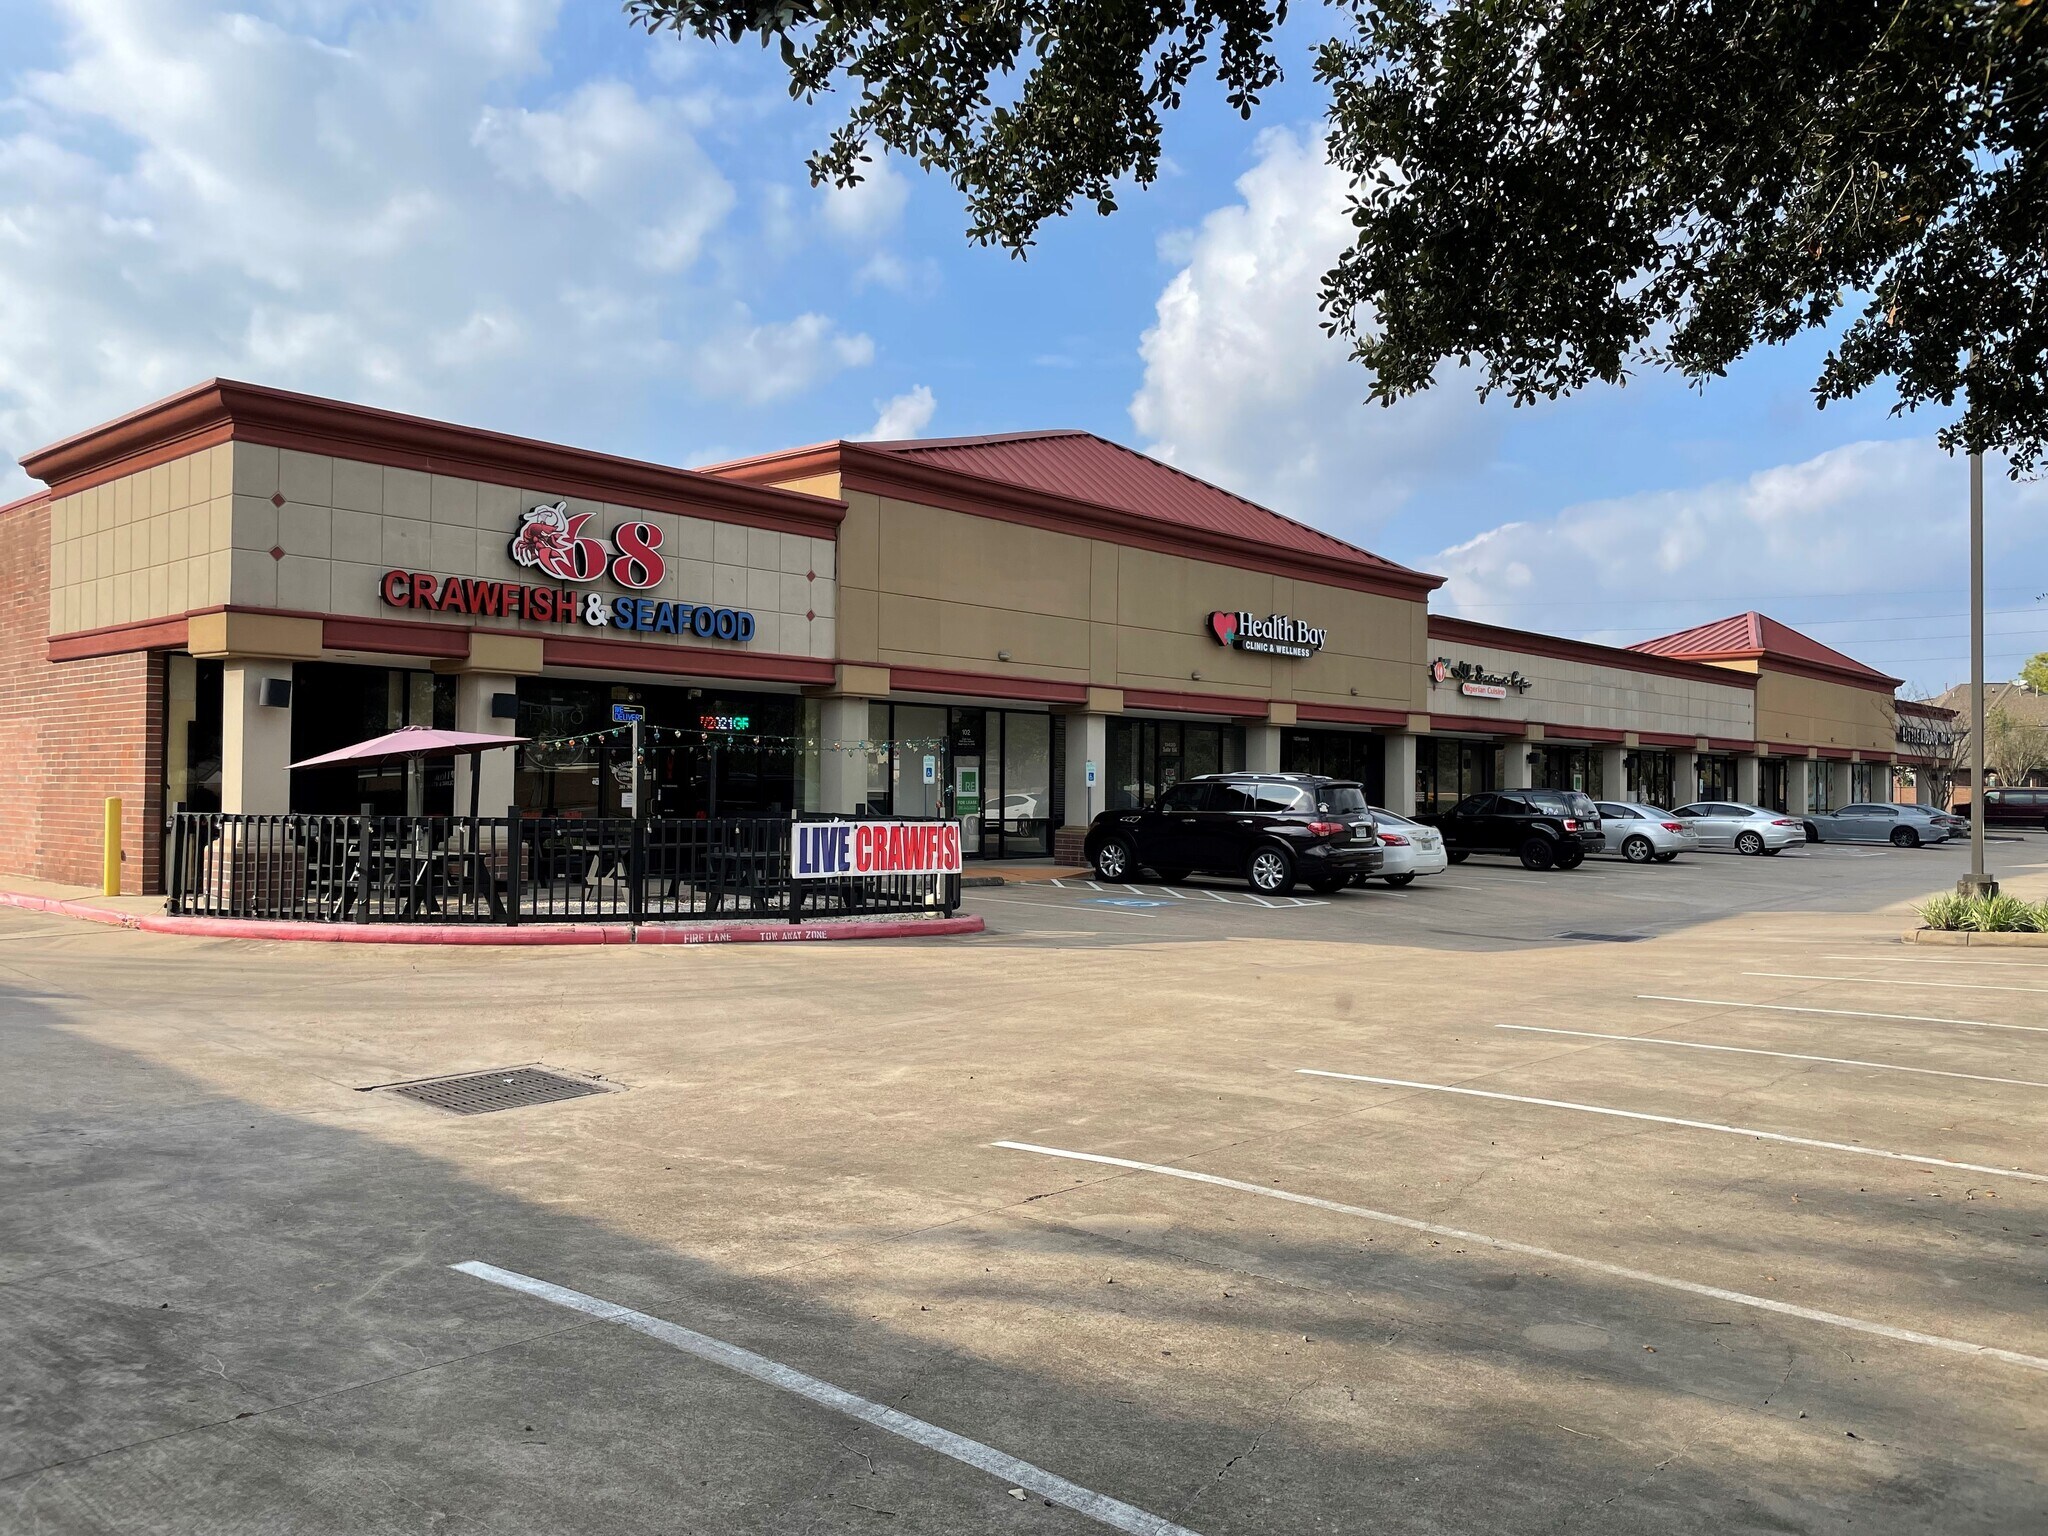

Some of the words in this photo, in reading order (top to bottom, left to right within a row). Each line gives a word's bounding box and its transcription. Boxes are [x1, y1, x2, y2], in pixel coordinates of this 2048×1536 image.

[560, 512, 667, 591] 68
[382, 569, 578, 624] CRAWFISH
[584, 593, 608, 628] &
[612, 596, 756, 642] SEAFOOD
[1239, 611, 1294, 642] Health
[1298, 620, 1328, 651] Bay
[1245, 641, 1269, 653] CLINIC
[1269, 643, 1275, 654] &
[1276, 645, 1311, 658] WELLNESS
[1464, 684, 1486, 694] Nigerian
[1487, 686, 1506, 696] Cuisine
[965, 782, 975, 791] RE
[799, 826, 851, 874] LIVE
[684, 933, 704, 944] FIRE
[707, 932, 732, 943] LANE
[760, 931, 778, 941] TOW
[781, 931, 802, 941] AWAY
[805, 930, 828, 940] ZONE
